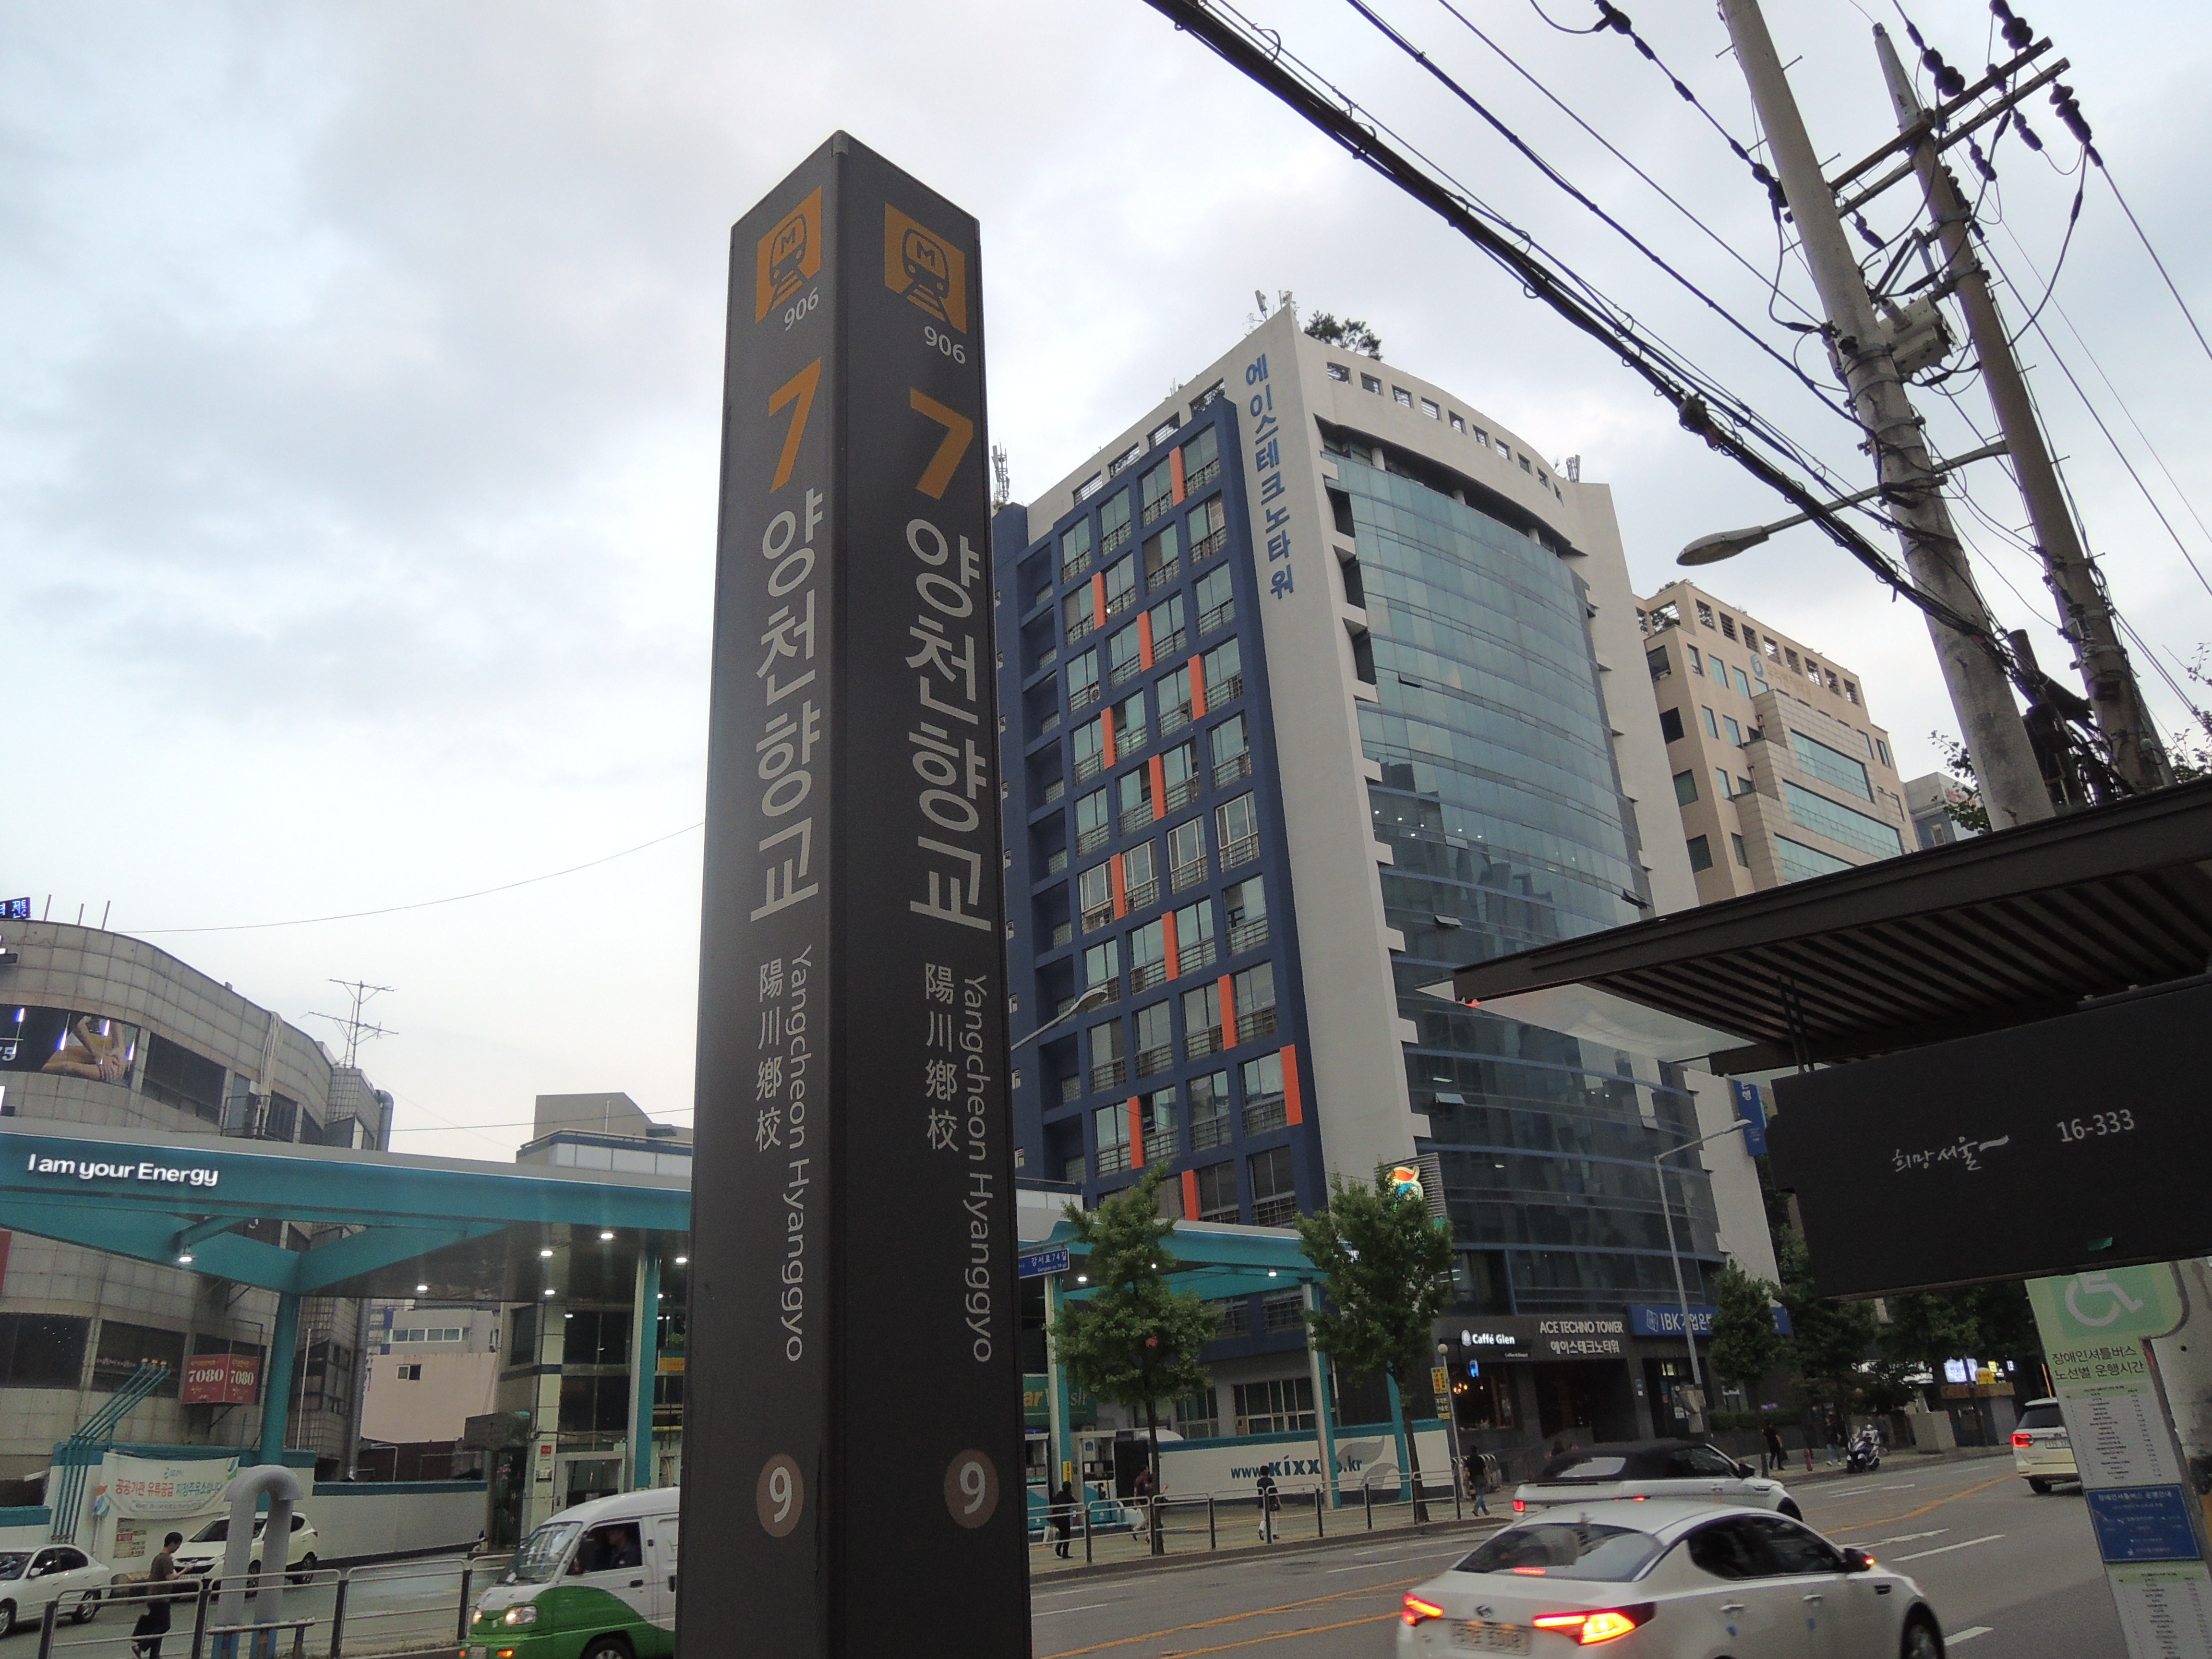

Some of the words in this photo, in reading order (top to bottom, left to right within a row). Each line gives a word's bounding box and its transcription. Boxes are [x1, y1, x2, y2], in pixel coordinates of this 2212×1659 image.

[784, 287, 819, 331] 906
[924, 326, 966, 364] 906
[769, 357, 821, 494] 7
[910, 387, 974, 500] 7
[1245, 353, 1295, 600] 에이스테크노타워
[750, 487, 823, 922] 양천향교
[904, 518, 992, 932] 양천향교
[785, 944, 812, 1149] Yangcheon
[960, 975, 991, 1161] Yangcheon
[2056, 1109, 2135, 1142] 16-333
[28, 1154, 36, 1170] I
[38, 1158, 75, 1174] am
[79, 1162, 135, 1179] your
[137, 1163, 218, 1187] Energy
[781, 1158, 810, 1362] Hyanggyo
[963, 1172, 993, 1362] Hyanggyo
[1496, 1334, 1515, 1344] Glen
[1540, 1321, 1559, 1334] ACE
[1560, 1322, 1595, 1334] TECHNO
[1596, 1321, 1623, 1334] TOWER
[1660, 1313, 1681, 1330] IBK
[1551, 1340, 1620, 1354] 에이스테크노타워
[2052, 1346, 2137, 1365] 장애인셔틀버스
[188, 1369, 224, 1383] 7080
[230, 1370, 254, 1385] 7080
[2055, 1367, 2092, 1380] 노선별
[2095, 1360, 2145, 1377] 운행시간
[1023, 1391, 1043, 1407] ar
[116, 1479, 145, 1496] 공공기관
[147, 1481, 174, 1497] 유류공급
[769, 1467, 793, 1523] 9
[960, 1461, 986, 1515] 9
